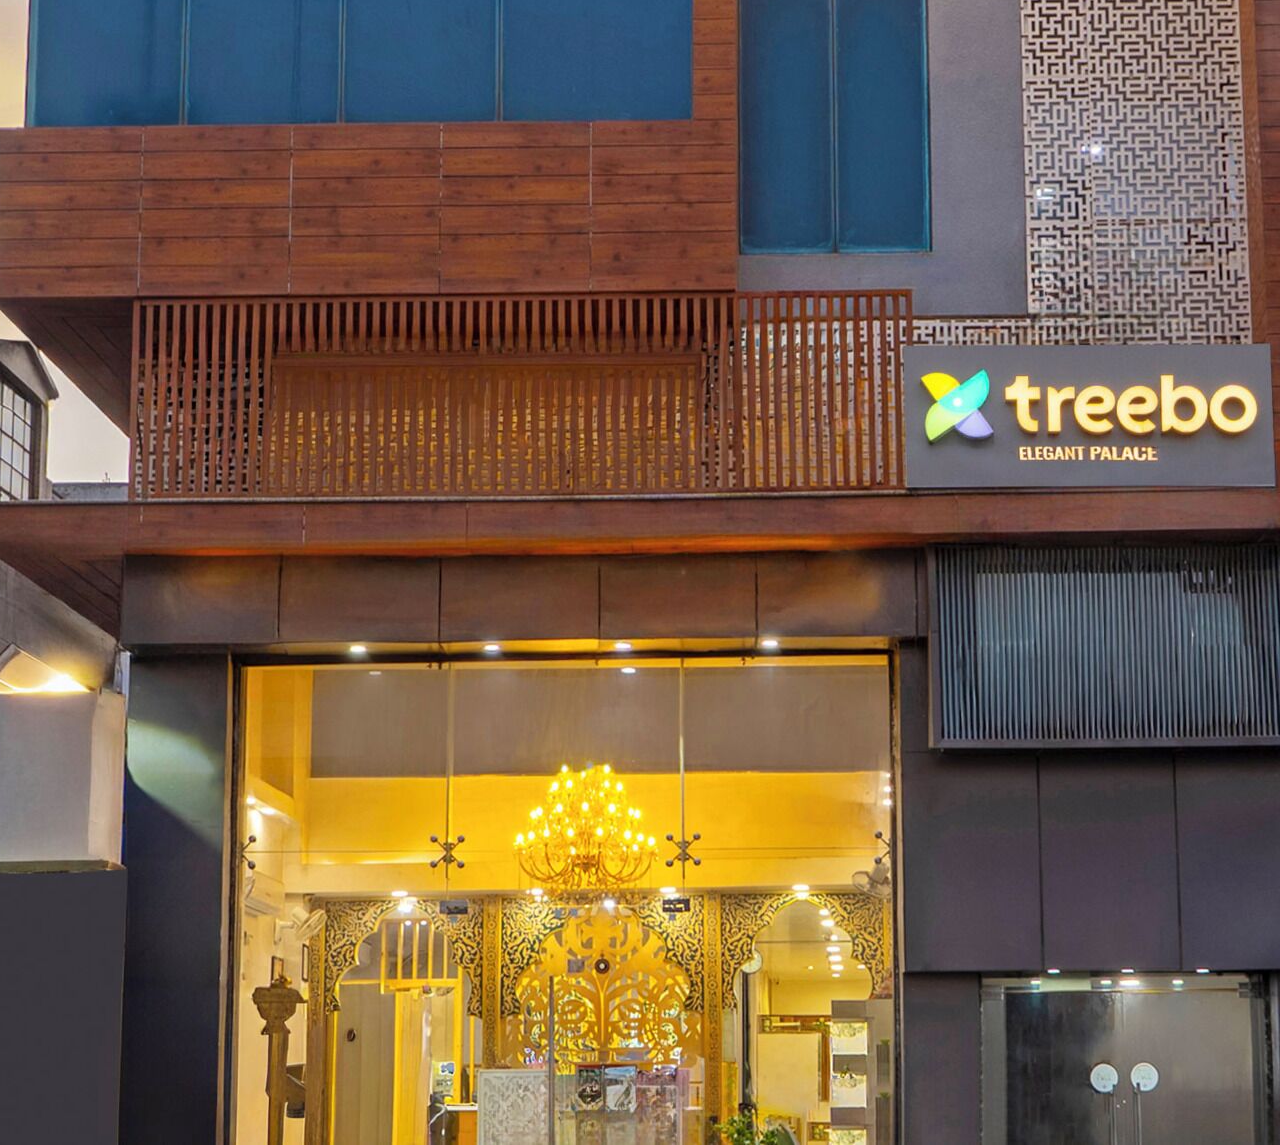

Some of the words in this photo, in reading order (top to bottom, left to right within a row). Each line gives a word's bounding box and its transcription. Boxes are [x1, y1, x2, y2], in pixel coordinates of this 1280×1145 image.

[1004, 374, 1258, 434] treebo
[1019, 446, 1085, 462] ELEGANT
[1090, 446, 1159, 461] PALACE
